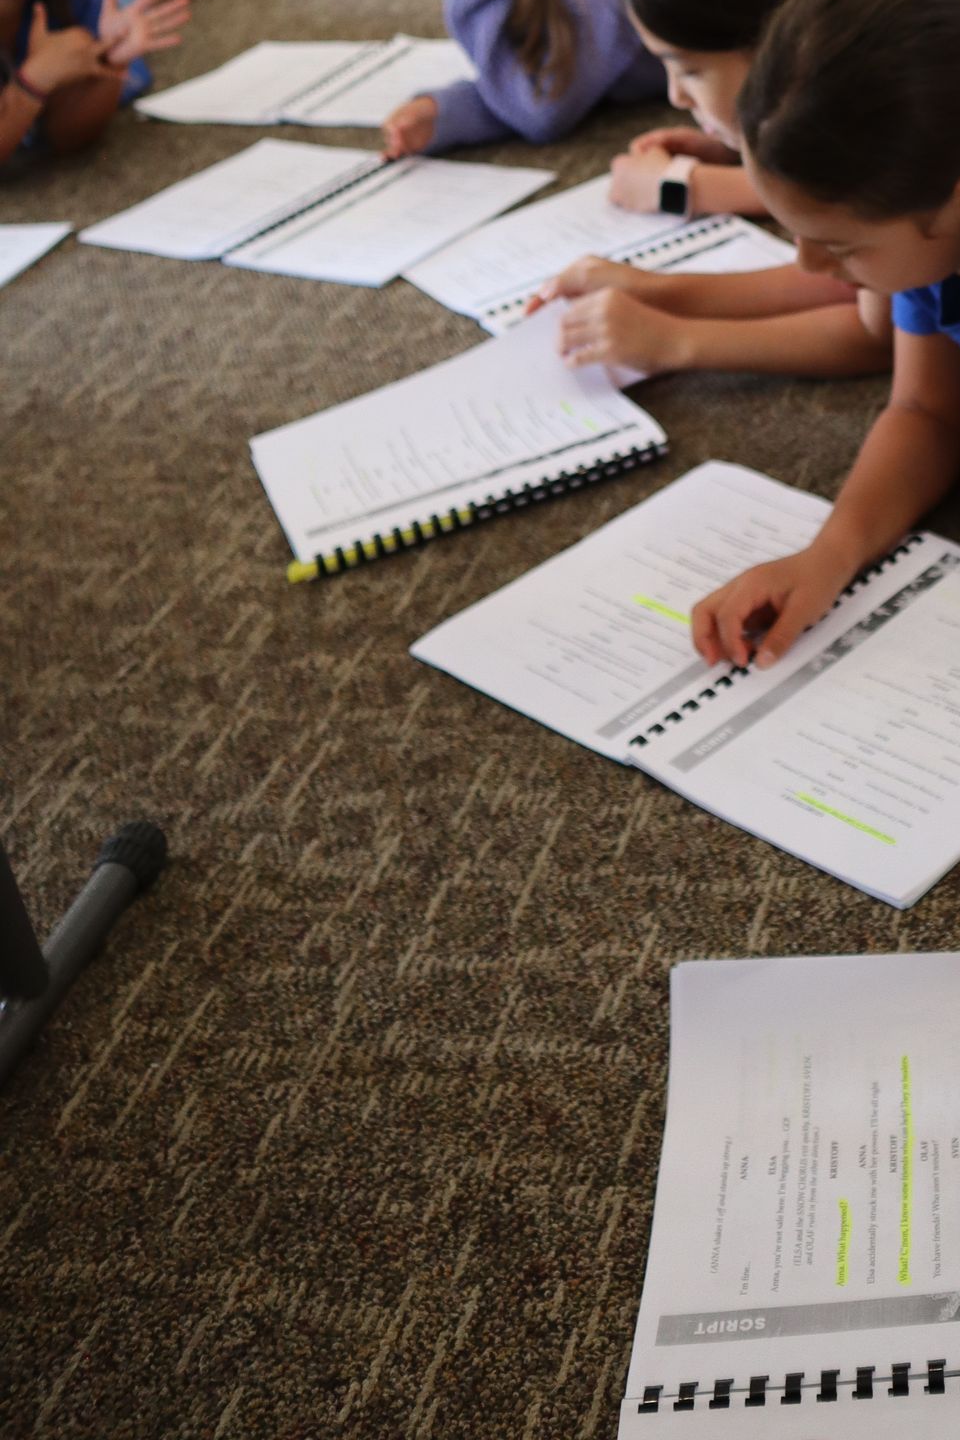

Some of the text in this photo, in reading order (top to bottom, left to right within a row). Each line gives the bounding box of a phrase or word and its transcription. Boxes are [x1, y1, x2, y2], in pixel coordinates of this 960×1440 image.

[859, 1144, 868, 1169] ANNA
[888, 1134, 899, 1174] KRISTOFF
[920, 1140, 930, 1162] OLAF
[952, 1137, 960, 1159] SVEN
[740, 1156, 750, 1180] ANNA
[768, 1155, 778, 1176] ELSA
[830, 1140, 840, 1180] KRISTOFF
[838, 1201, 850, 1242] happened?
[836, 1242, 848, 1262] What
[693, 1317, 766, 1335] SCRIPT
